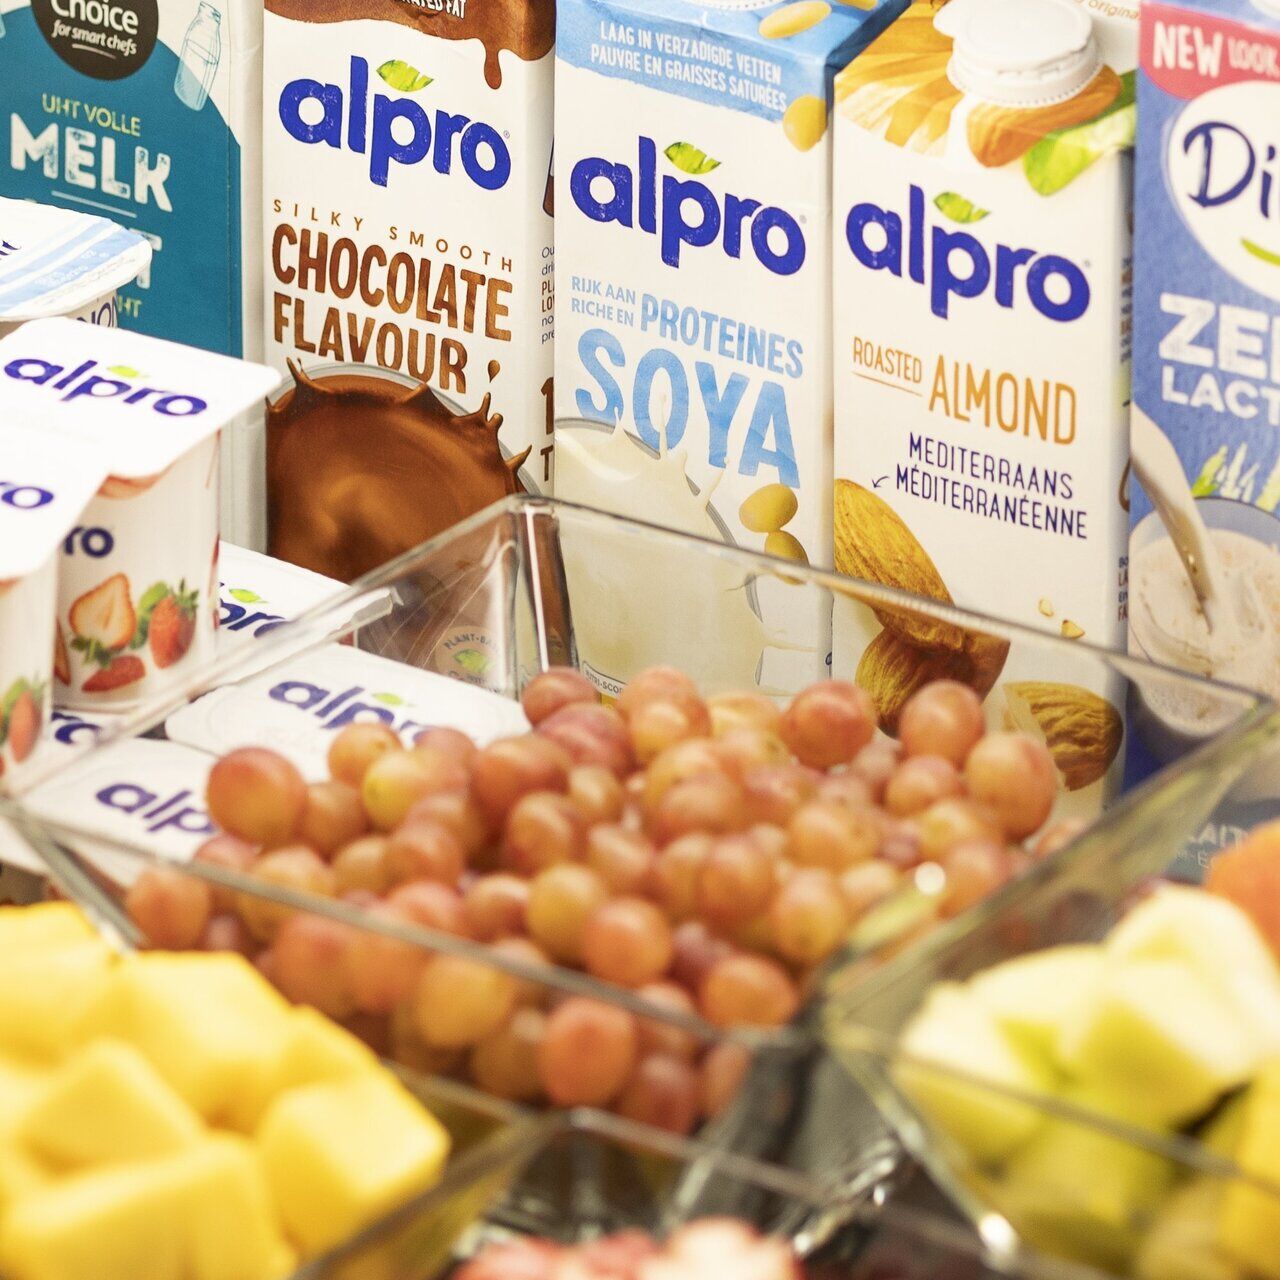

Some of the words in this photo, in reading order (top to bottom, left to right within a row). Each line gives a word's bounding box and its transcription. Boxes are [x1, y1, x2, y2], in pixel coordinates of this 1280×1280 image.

[51, 20, 71, 39] for
[71, 27, 106, 48] smart
[107, 31, 137, 56] chefs
[600, 21, 635, 46] LAAG
[637, 29, 652, 50] IN
[656, 33, 734, 72] VERZADIGDE
[735, 52, 782, 84] VETTEN
[1152, 20, 1223, 79] NEW
[42, 93, 79, 120] UHT
[84, 103, 141, 137] VOLLE
[591, 48, 641, 73] PAUVRE
[644, 56, 662, 77] EN
[665, 59, 727, 96] GRAISSES
[729, 75, 788, 114] SATURÉES
[279, 55, 511, 191] alpro
[10, 112, 173, 213] MELK
[273, 199, 363, 232] SILKY
[389, 226, 513, 272] SMOOTH
[570, 135, 806, 276] alpro
[272, 223, 513, 342] CHOCOLATE
[845, 183, 1091, 323] alpro
[273, 291, 469, 395] FLAVOUR
[571, 297, 614, 321] RICHE
[616, 308, 634, 328] EN
[572, 275, 601, 297] RIJK
[605, 282, 636, 306] AAN
[641, 292, 804, 379] PROTEINES
[2, 357, 208, 417] alpro
[575, 327, 801, 489] SOYA
[852, 336, 923, 384] ROASTED
[927, 354, 1077, 446] ALMOND
[895, 463, 1089, 540] MÉDITERRANÉENNE
[909, 431, 1074, 501] MEDITERRAANS
